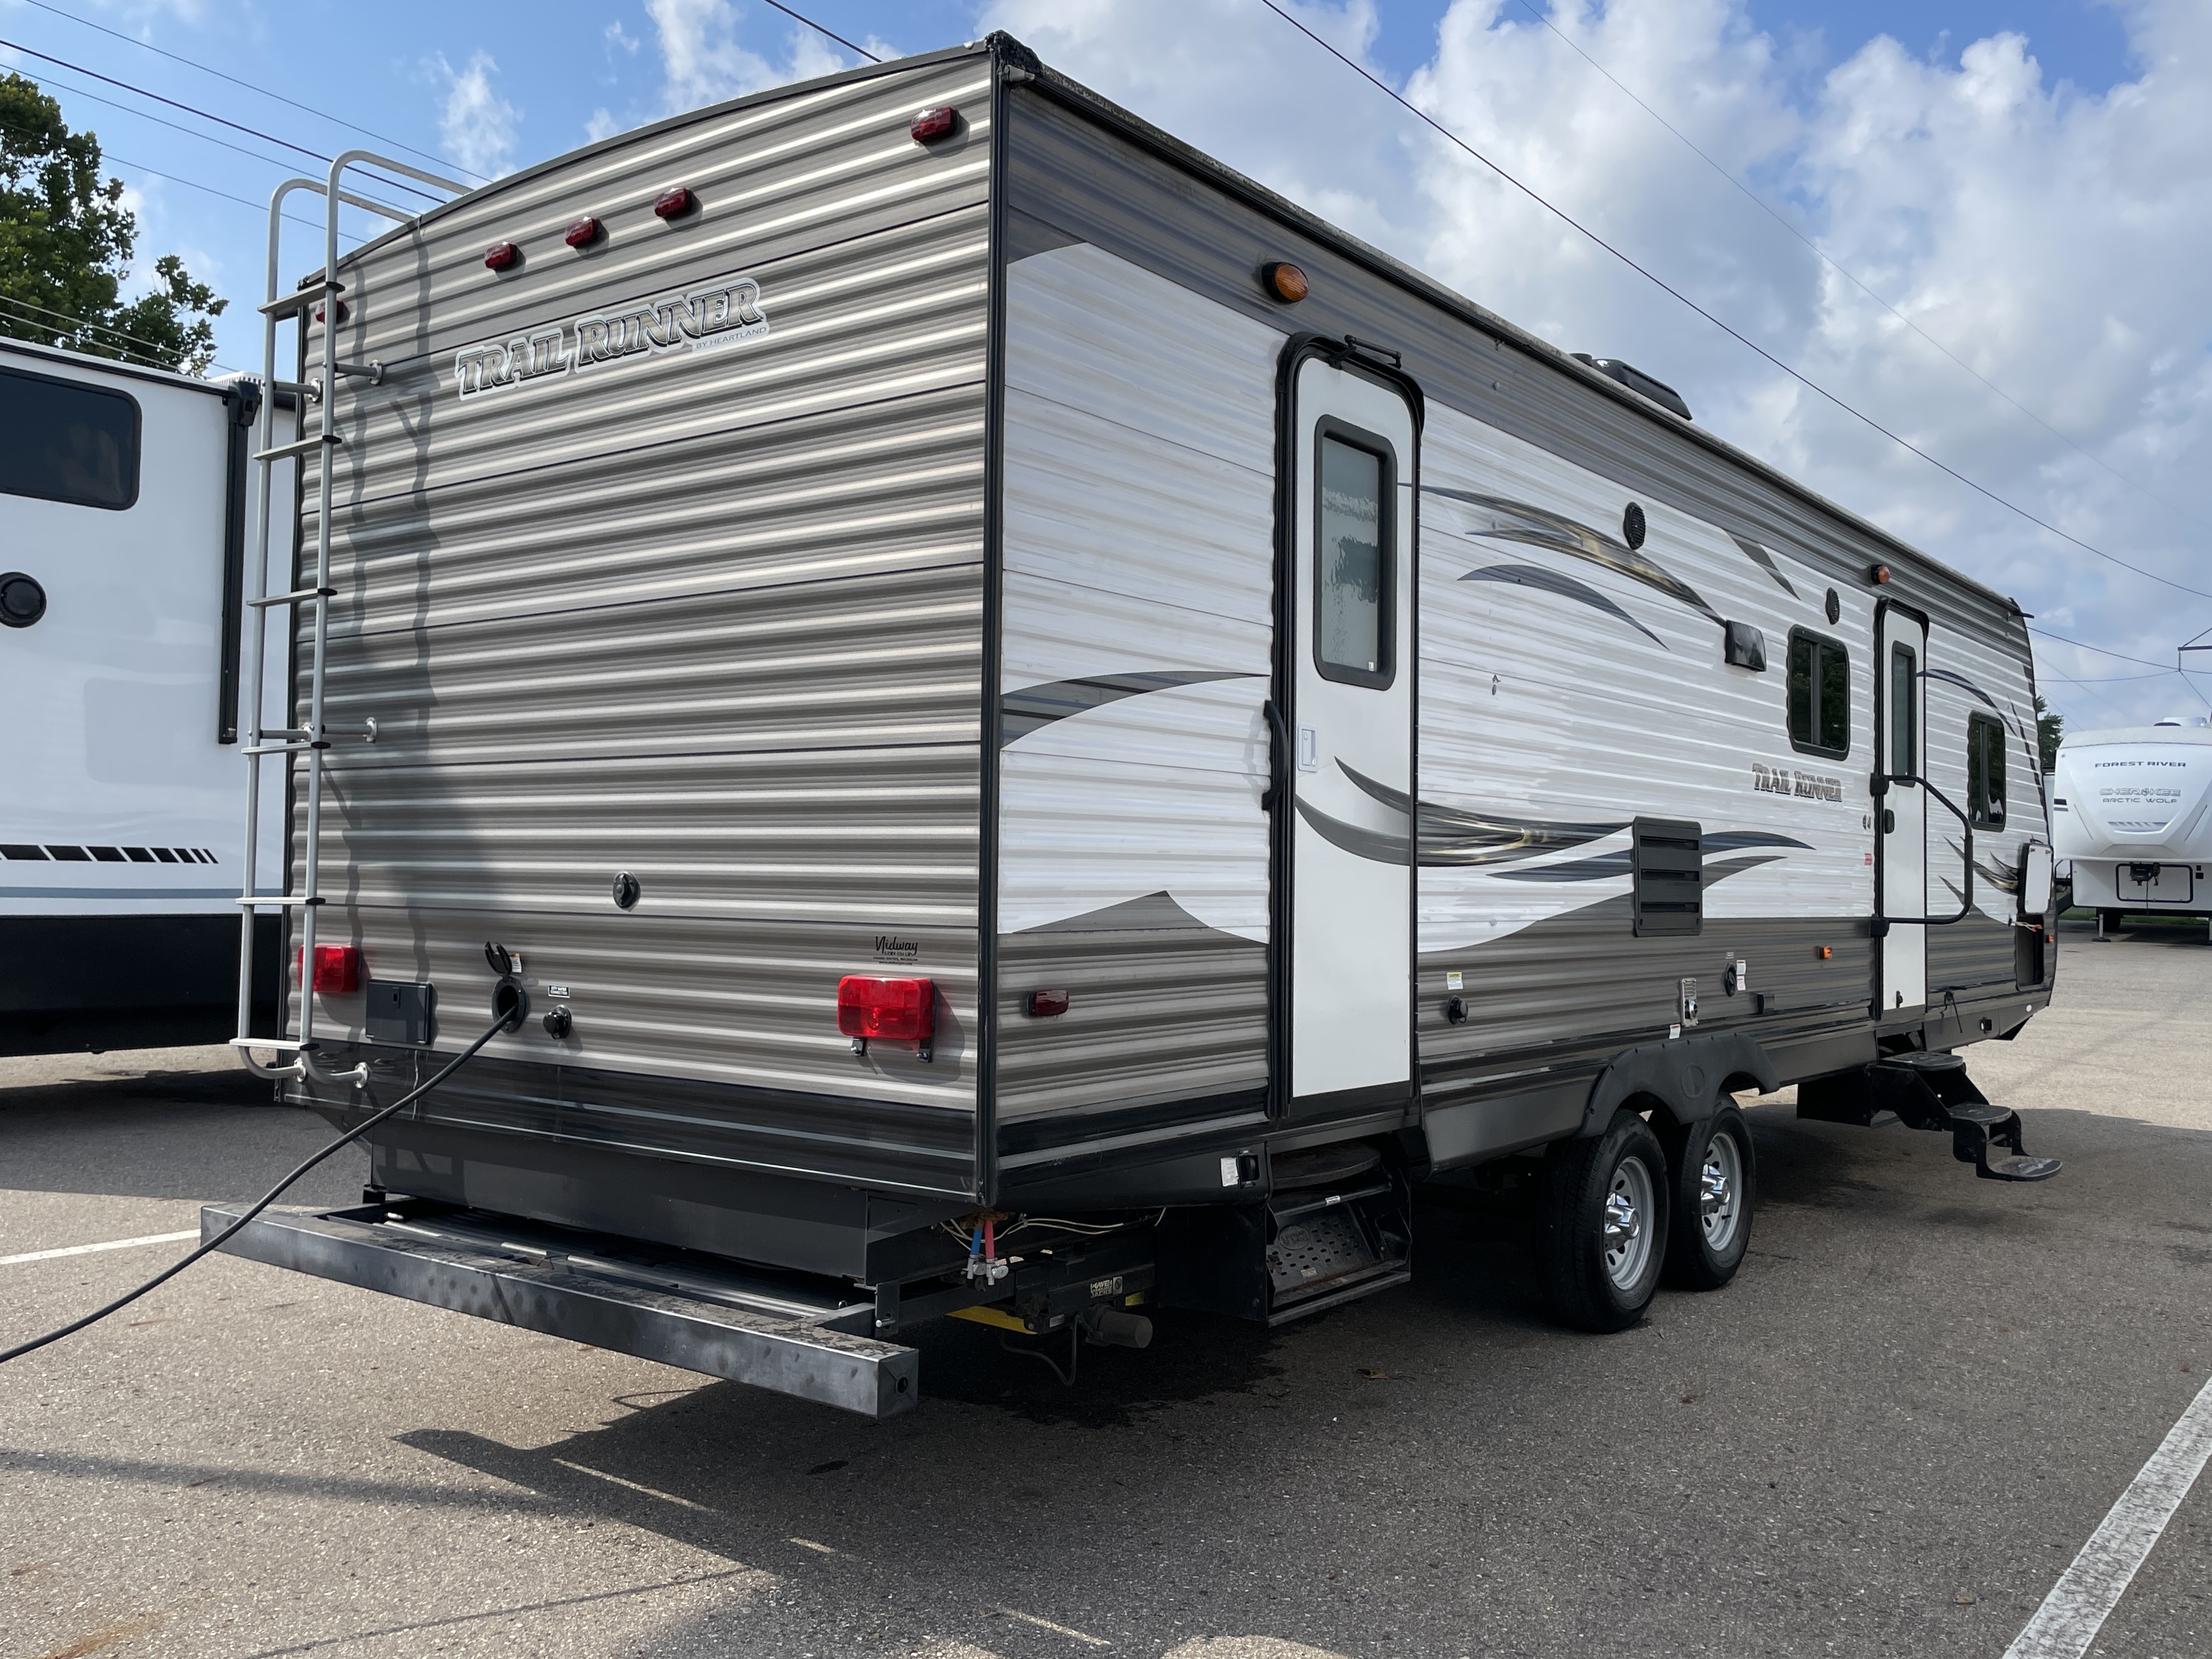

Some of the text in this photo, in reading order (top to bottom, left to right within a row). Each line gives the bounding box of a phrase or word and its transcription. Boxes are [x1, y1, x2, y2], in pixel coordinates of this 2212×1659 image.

[457, 284, 765, 396] TRAIL RUNNER
[696, 326, 767, 349] BY HEARTLAND
[1752, 763, 1842, 802] TRAIL RUNNER
[2099, 787, 2181, 797] CHEROKEE
